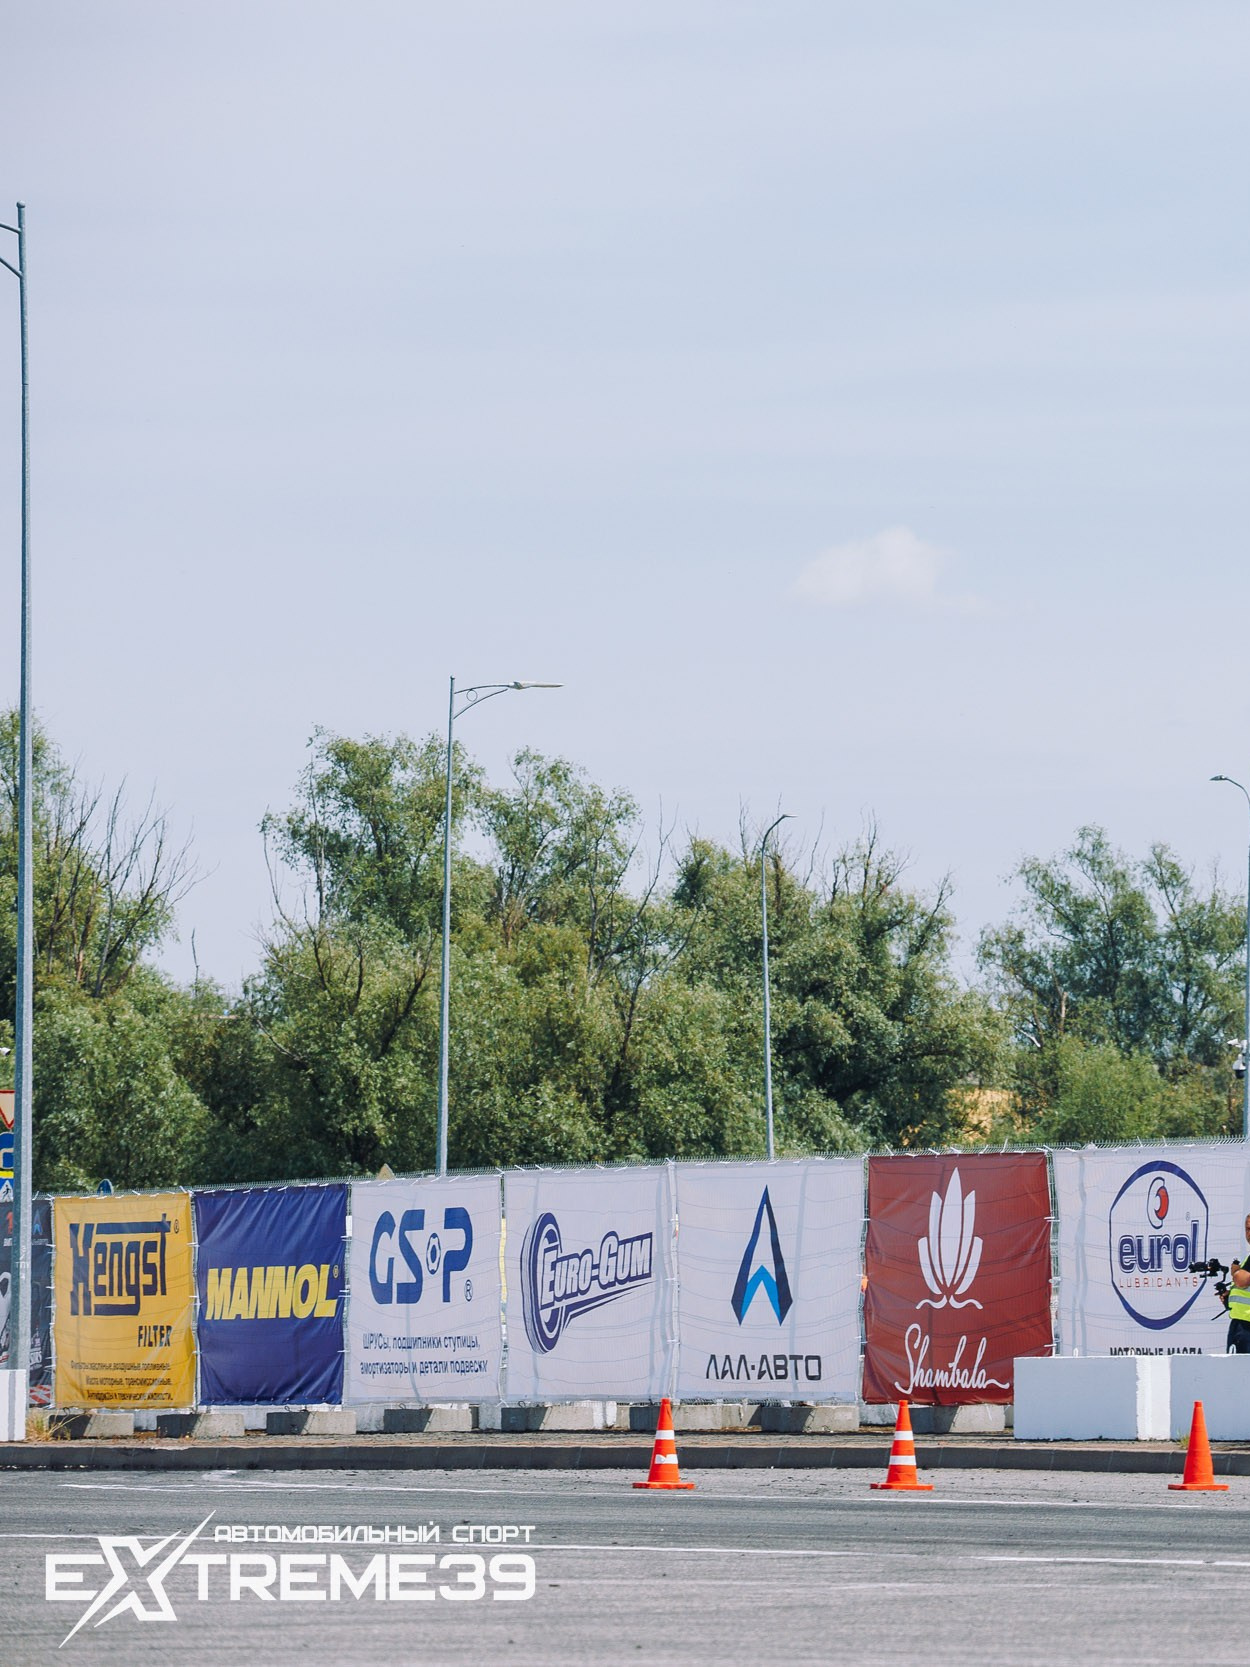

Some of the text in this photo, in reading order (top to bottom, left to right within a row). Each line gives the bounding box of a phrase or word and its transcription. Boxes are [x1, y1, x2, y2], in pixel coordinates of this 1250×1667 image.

[69, 1213, 171, 1316] Hengst
[1119, 1219, 1200, 1273] eurol
[205, 1264, 338, 1321] MANNOL
[1119, 1276, 1199, 1288] LUBRICANTS
[137, 1325, 172, 1347] FILTER
[392, 1336, 441, 1352] подшипники
[443, 1336, 481, 1352] ступицы,
[359, 1361, 411, 1379] амортизаторы
[419, 1360, 449, 1376] детали
[895, 1323, 1010, 1395] Shambala
